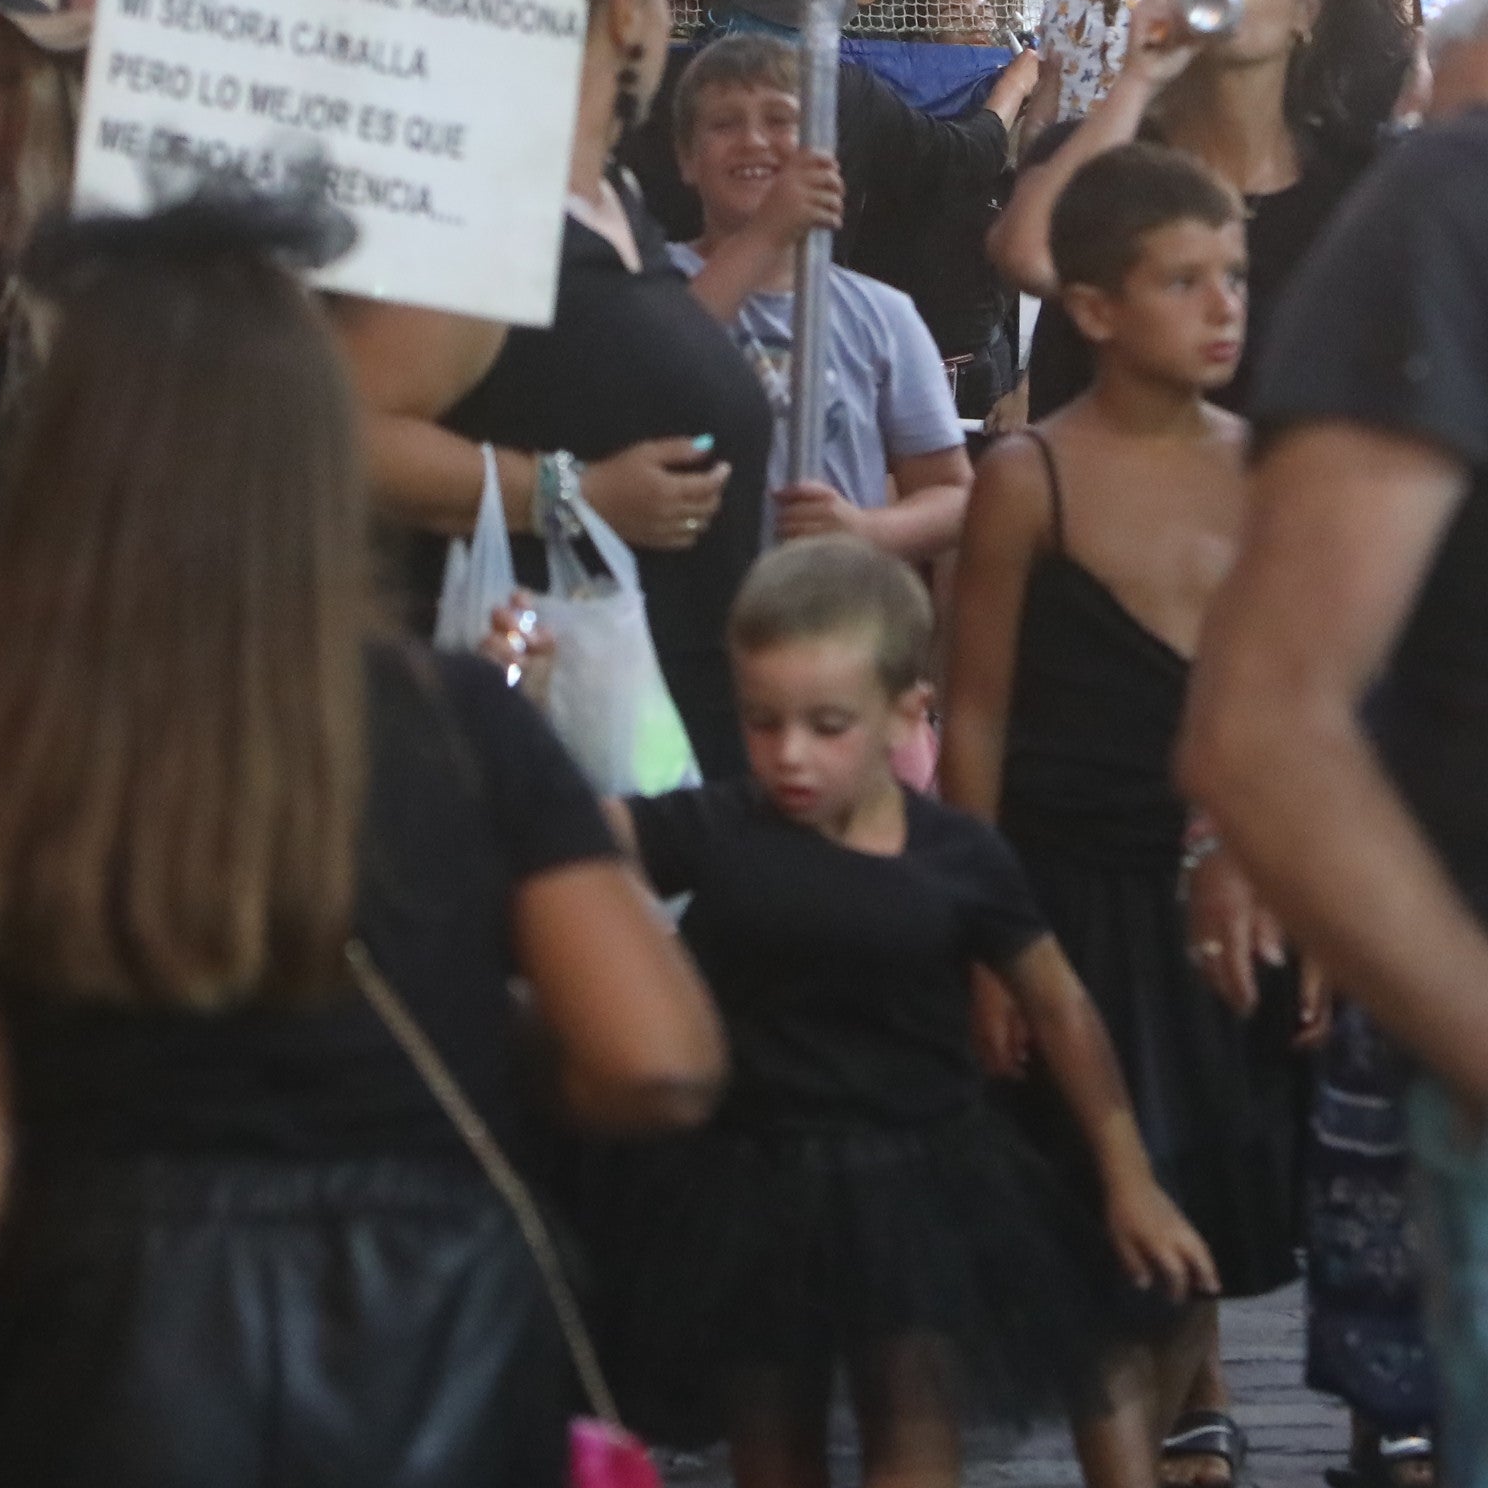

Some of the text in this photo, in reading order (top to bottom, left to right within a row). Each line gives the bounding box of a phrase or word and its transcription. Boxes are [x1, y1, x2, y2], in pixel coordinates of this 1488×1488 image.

[288, 20, 429, 80] CABALLA
[107, 51, 466, 162] PERO LO MEJOR ES QUE
[98, 116, 144, 158] ME
